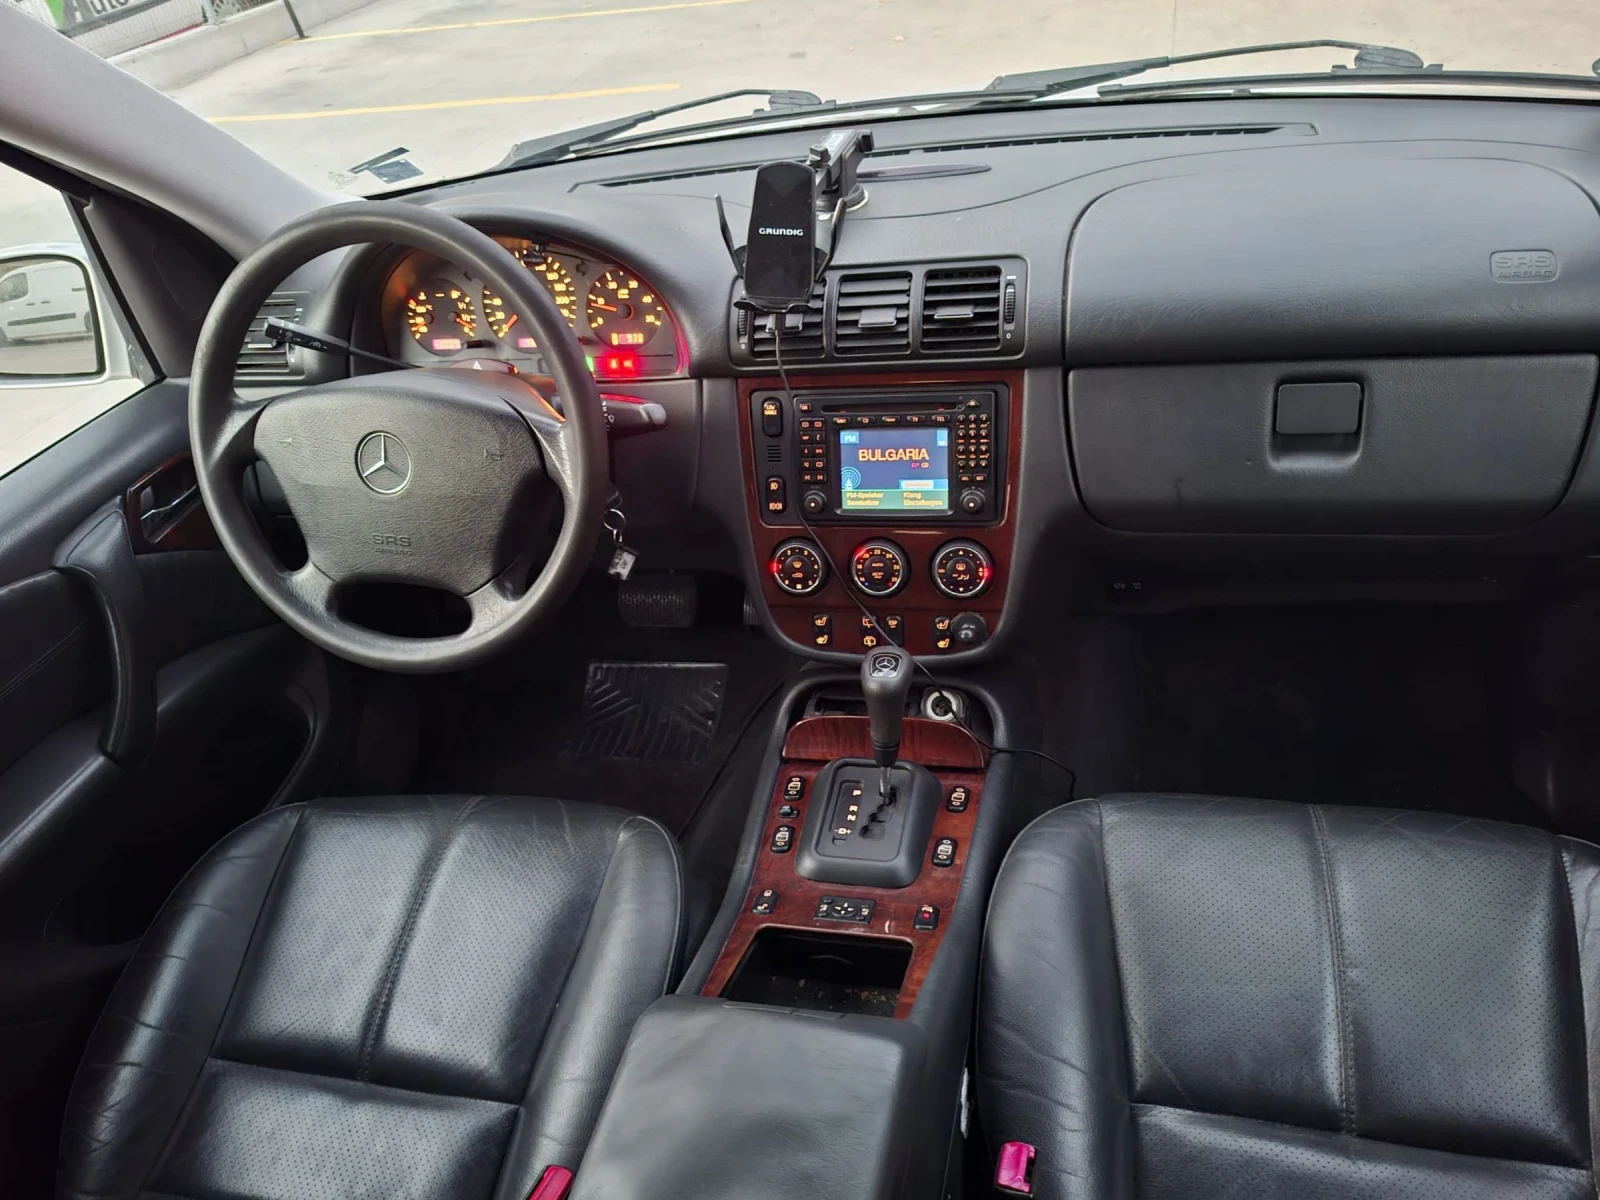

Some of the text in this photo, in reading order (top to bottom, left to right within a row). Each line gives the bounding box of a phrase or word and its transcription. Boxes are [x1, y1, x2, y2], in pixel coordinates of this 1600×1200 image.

[759, 227, 804, 236] GRUNDIG
[1496, 256, 1552, 268] SRS
[555, 296, 570, 304] 200
[858, 448, 930, 461] BULGARIA
[372, 533, 412, 547] SRS
